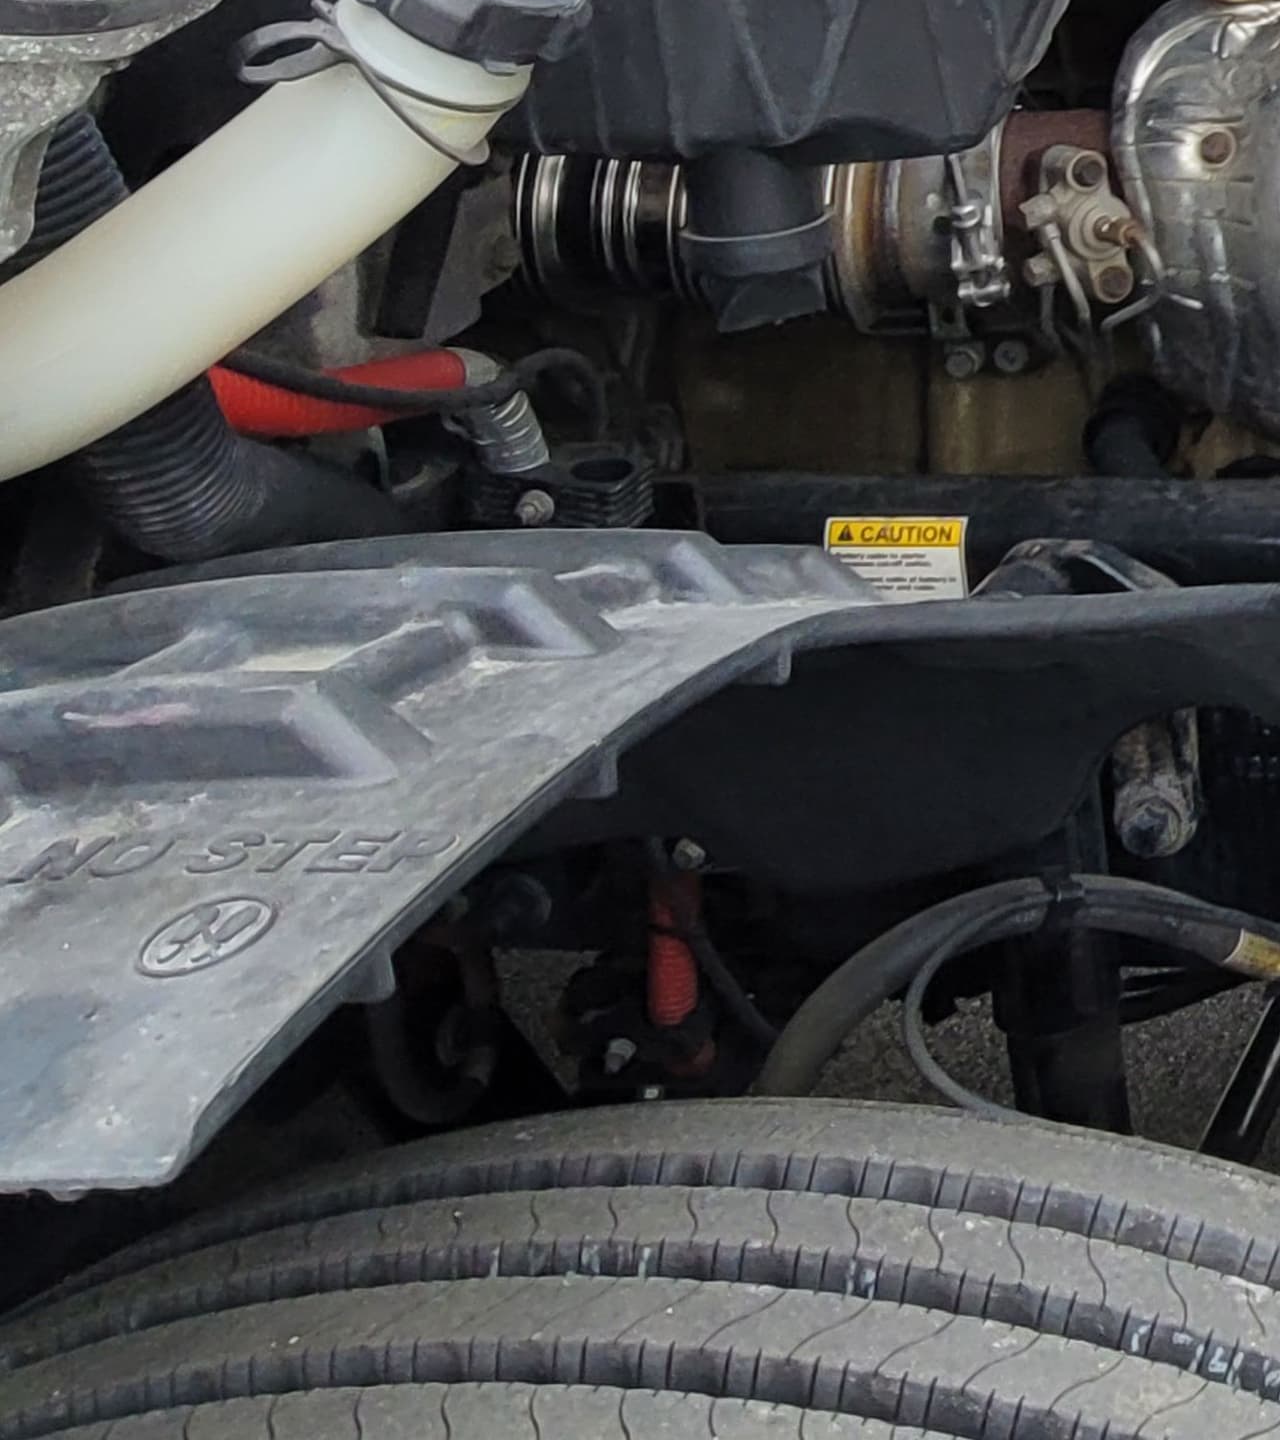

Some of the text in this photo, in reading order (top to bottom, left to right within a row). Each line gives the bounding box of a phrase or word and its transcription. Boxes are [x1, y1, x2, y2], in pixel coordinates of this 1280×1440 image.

[860, 525, 953, 543] CAUTION
[2, 829, 460, 884] NO STEP
